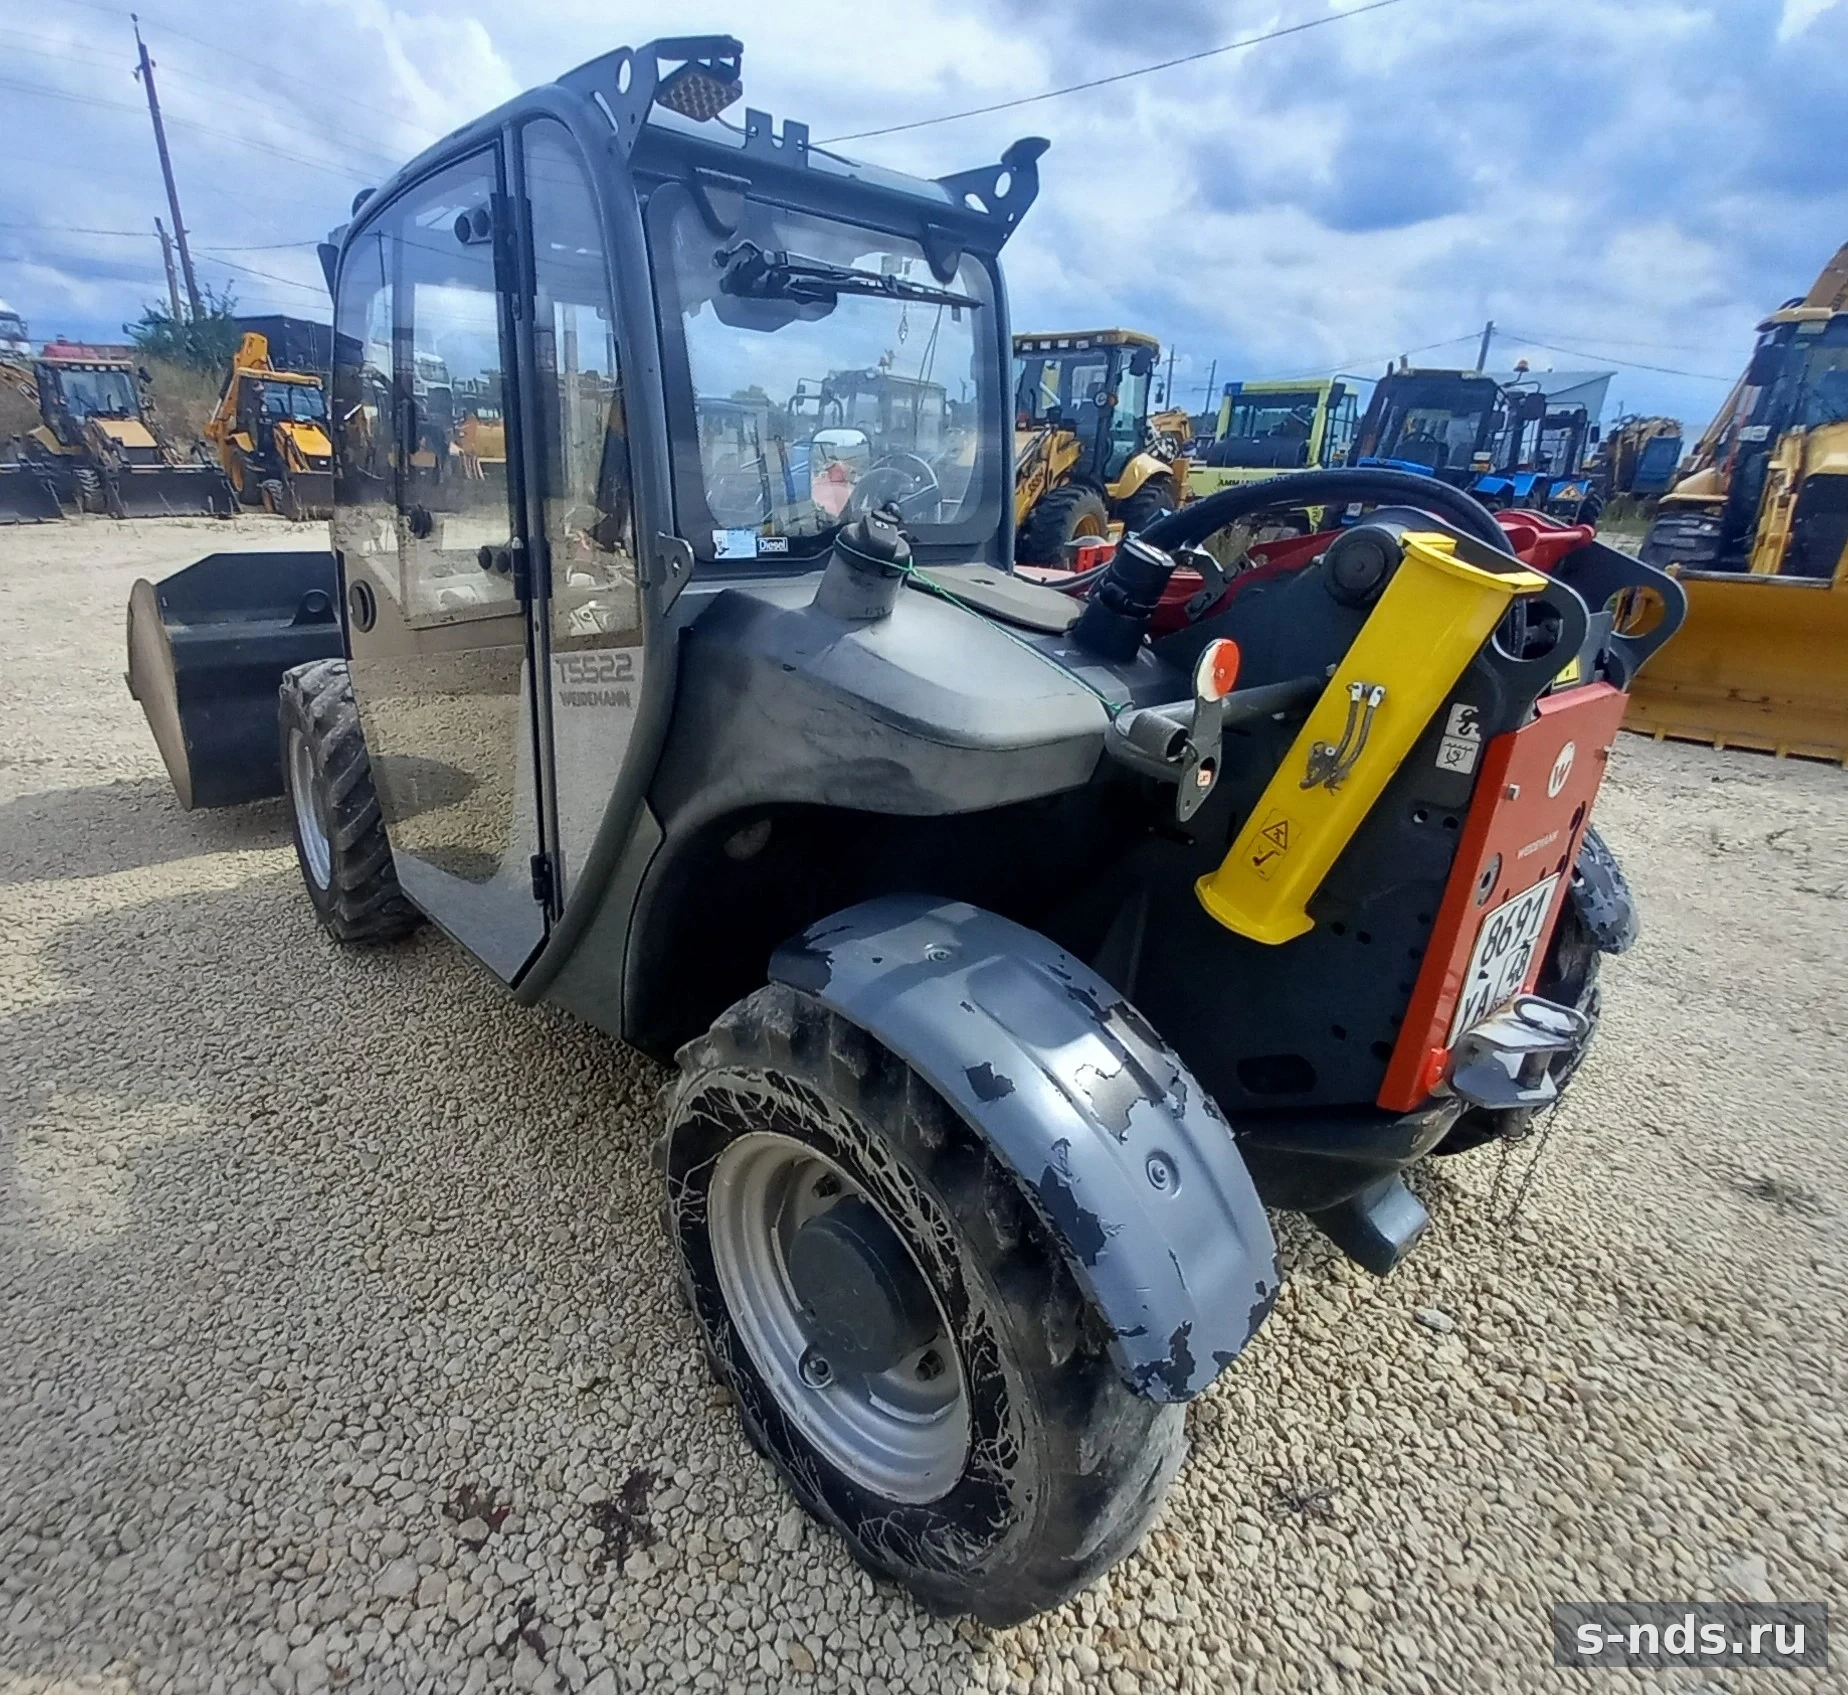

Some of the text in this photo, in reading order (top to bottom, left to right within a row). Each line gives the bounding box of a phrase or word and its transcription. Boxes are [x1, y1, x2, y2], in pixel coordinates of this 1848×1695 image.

[760, 539, 786, 550] Diesel
[559, 690, 632, 708] WEIDEMANN
[1552, 760, 1571, 789] W
[1480, 887, 1549, 967] 8691
[1506, 946, 1531, 988] 48
